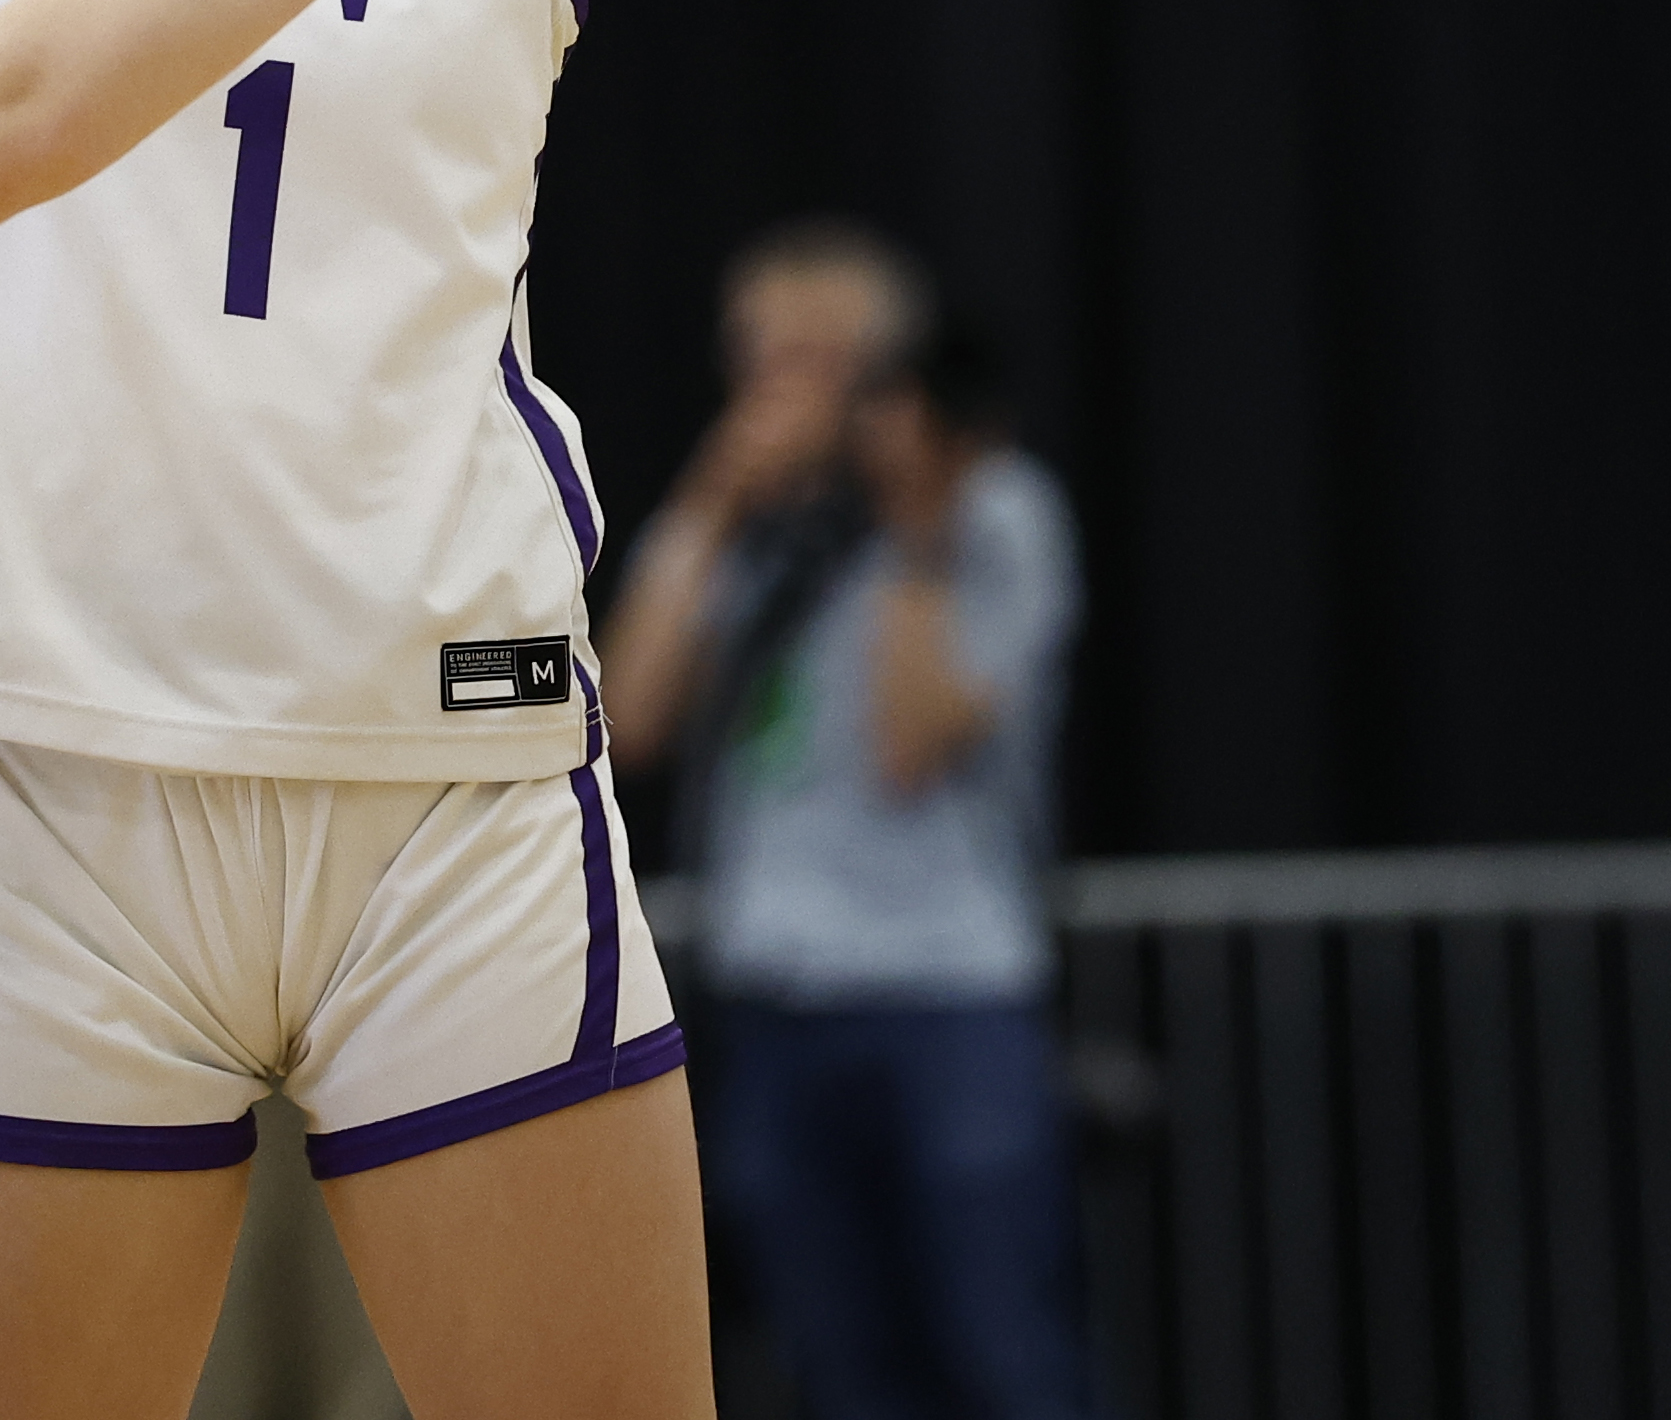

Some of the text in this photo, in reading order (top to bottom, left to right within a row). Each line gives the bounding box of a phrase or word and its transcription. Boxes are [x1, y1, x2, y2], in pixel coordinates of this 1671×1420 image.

[223, 60, 295, 320] 1
[449, 651, 512, 663] ENGINEERED
[531, 660, 555, 685] M
